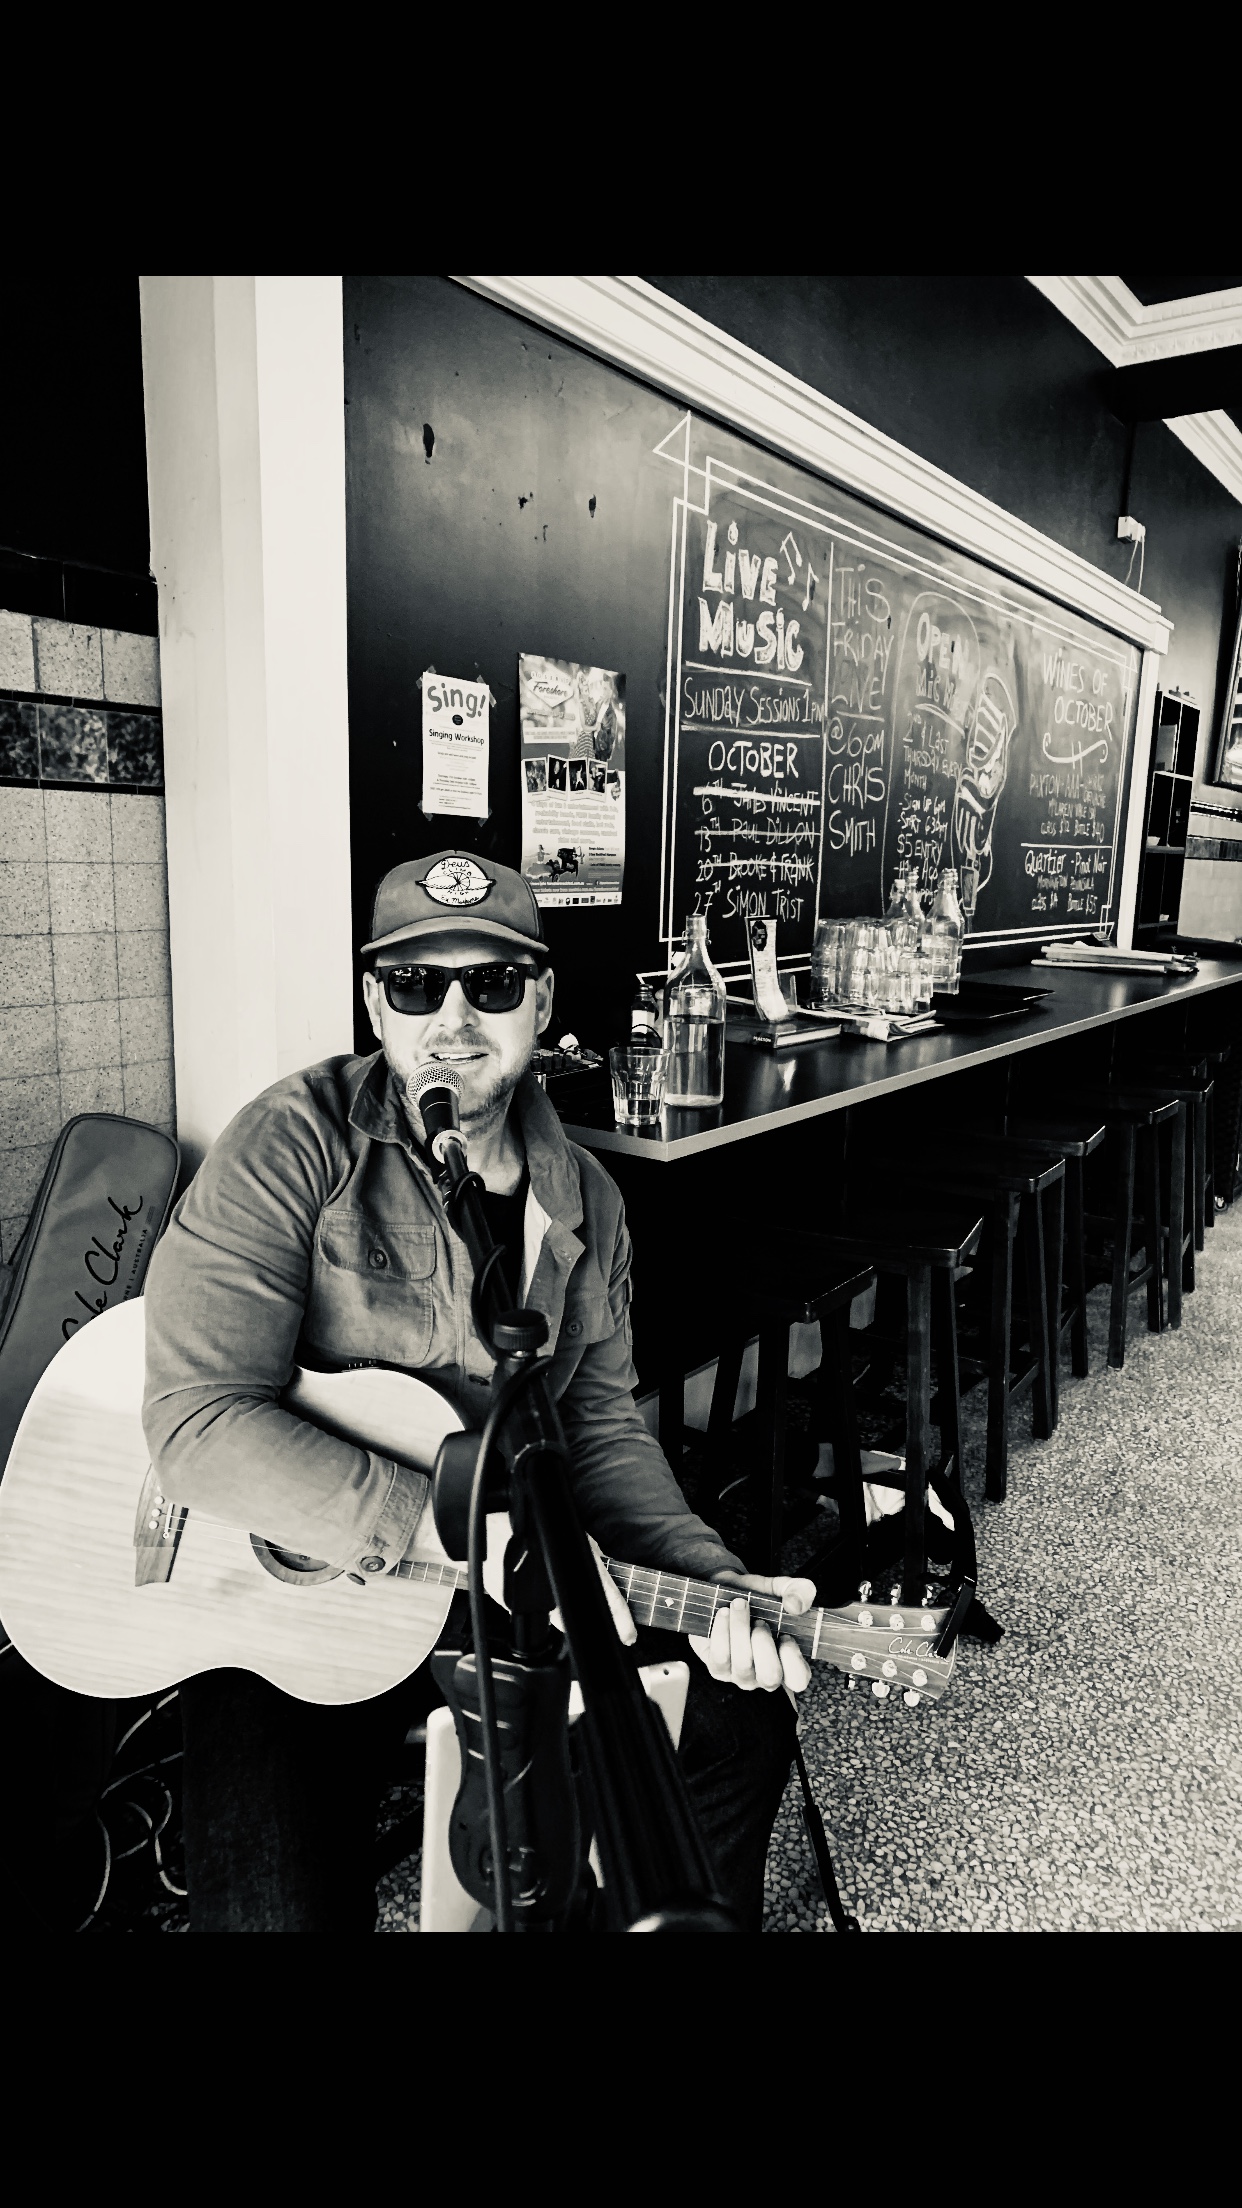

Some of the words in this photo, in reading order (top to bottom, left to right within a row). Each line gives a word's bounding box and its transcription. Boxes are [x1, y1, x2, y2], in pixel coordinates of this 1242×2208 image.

[427, 683, 486, 718] Sing!
[1092, 668, 1108, 696] OF
[429, 729, 453, 741] Singing
[454, 732, 485, 746] Workshop
[1054, 695, 1113, 741] OCTOBER
[708, 741, 799, 778] OCTOBER
[828, 762, 886, 810] CHRIS
[828, 810, 876, 857] SMITH
[897, 832, 913, 858] $5
[914, 839, 943, 867] ENTRY
[84, 1195, 143, 1286] Clark
[130, 1228, 149, 1276] AUSTRALIA
